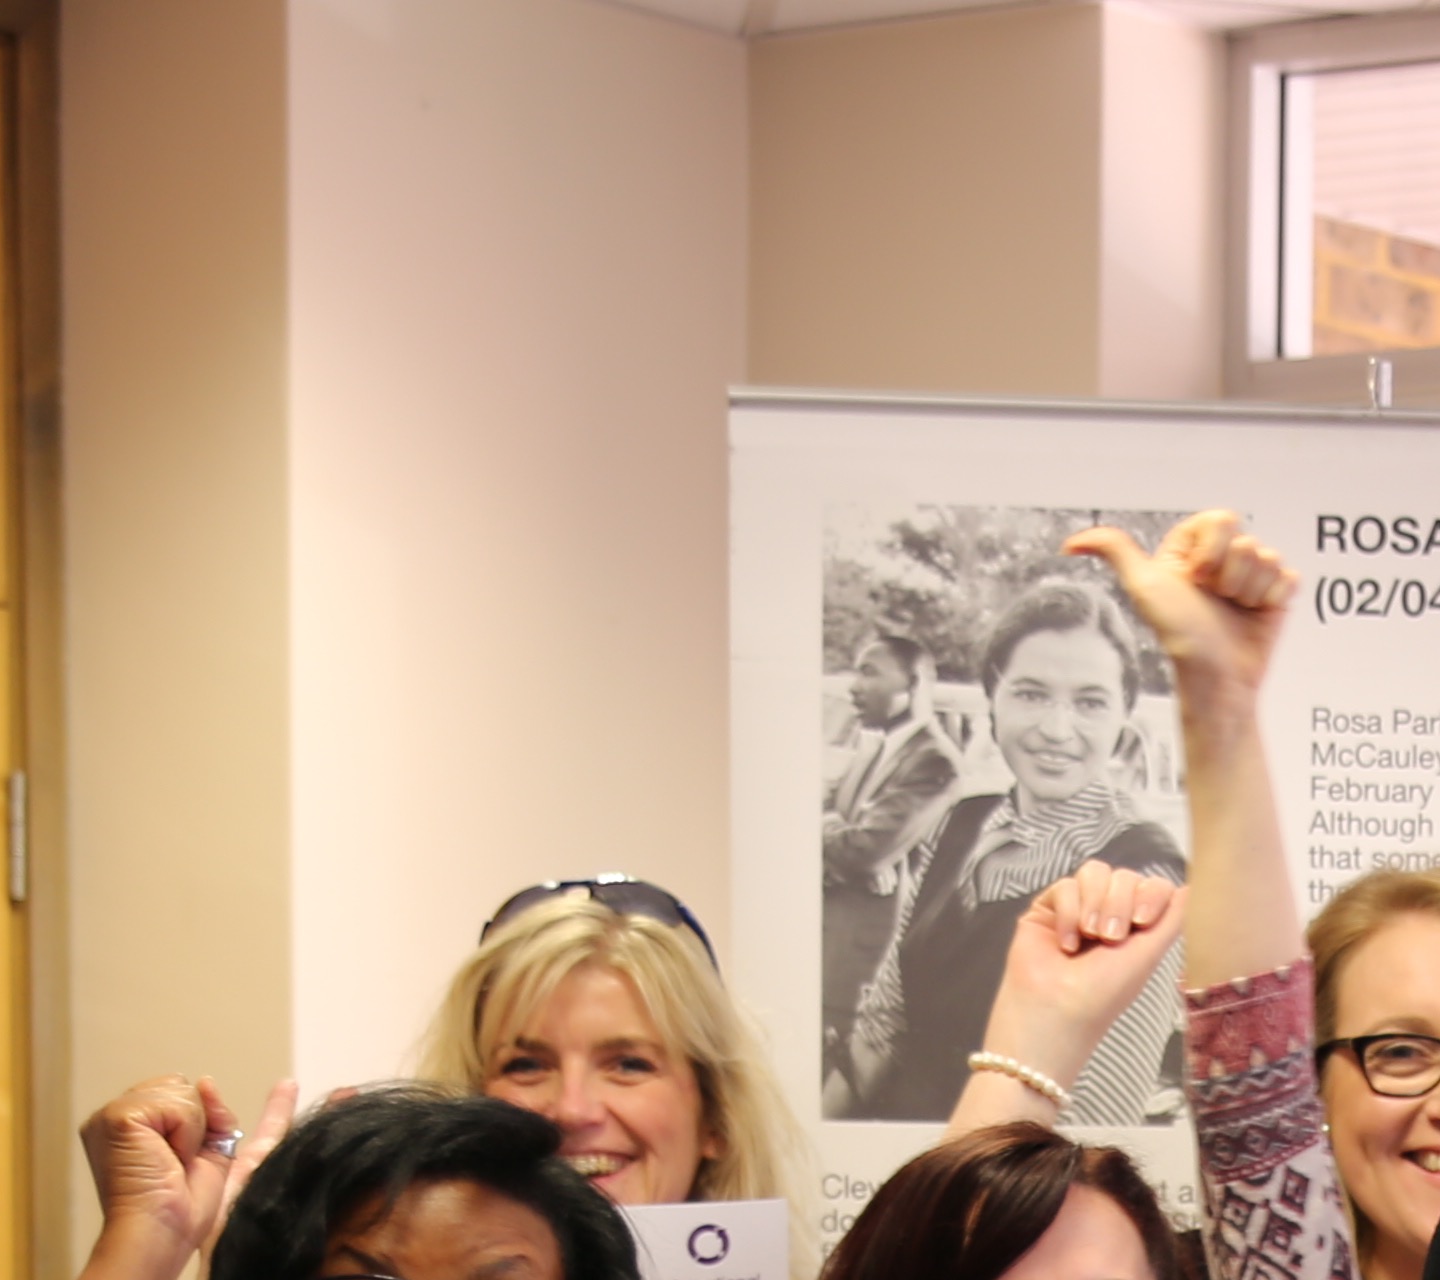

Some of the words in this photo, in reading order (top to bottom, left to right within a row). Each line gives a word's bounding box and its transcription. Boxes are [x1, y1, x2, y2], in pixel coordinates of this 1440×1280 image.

[1311, 709, 1383, 735] Rosa
[1310, 777, 1431, 809] February
[1308, 811, 1432, 845] Although
[1308, 848, 1361, 872] that
